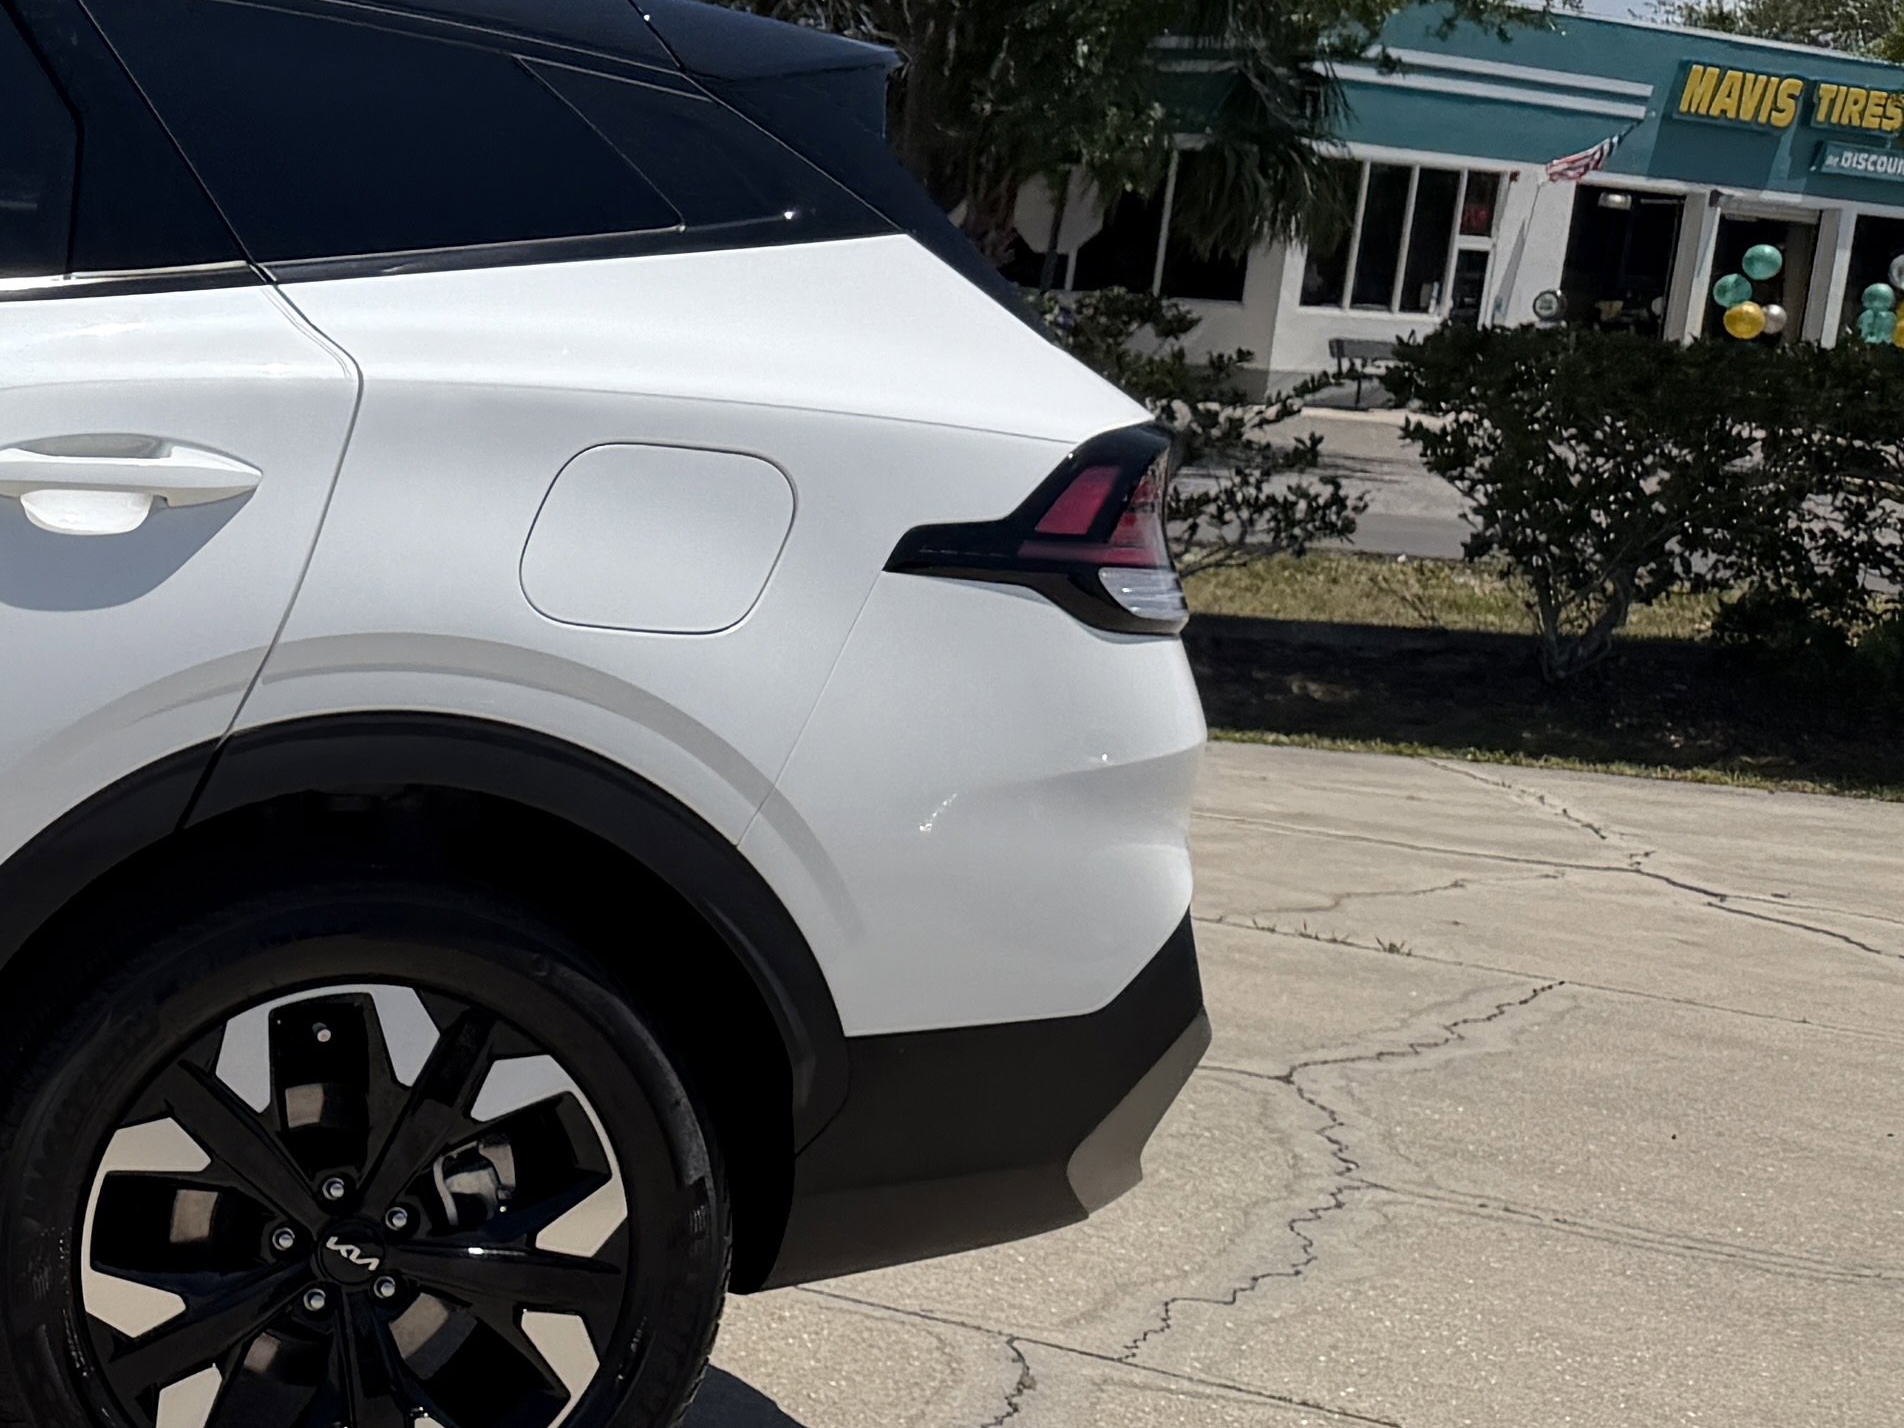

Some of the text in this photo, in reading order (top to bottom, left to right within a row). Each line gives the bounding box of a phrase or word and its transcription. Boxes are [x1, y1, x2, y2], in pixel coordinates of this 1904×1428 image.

[1679, 64, 1904, 131] MAVIS TIRES
[325, 1236, 380, 1271] KIA
